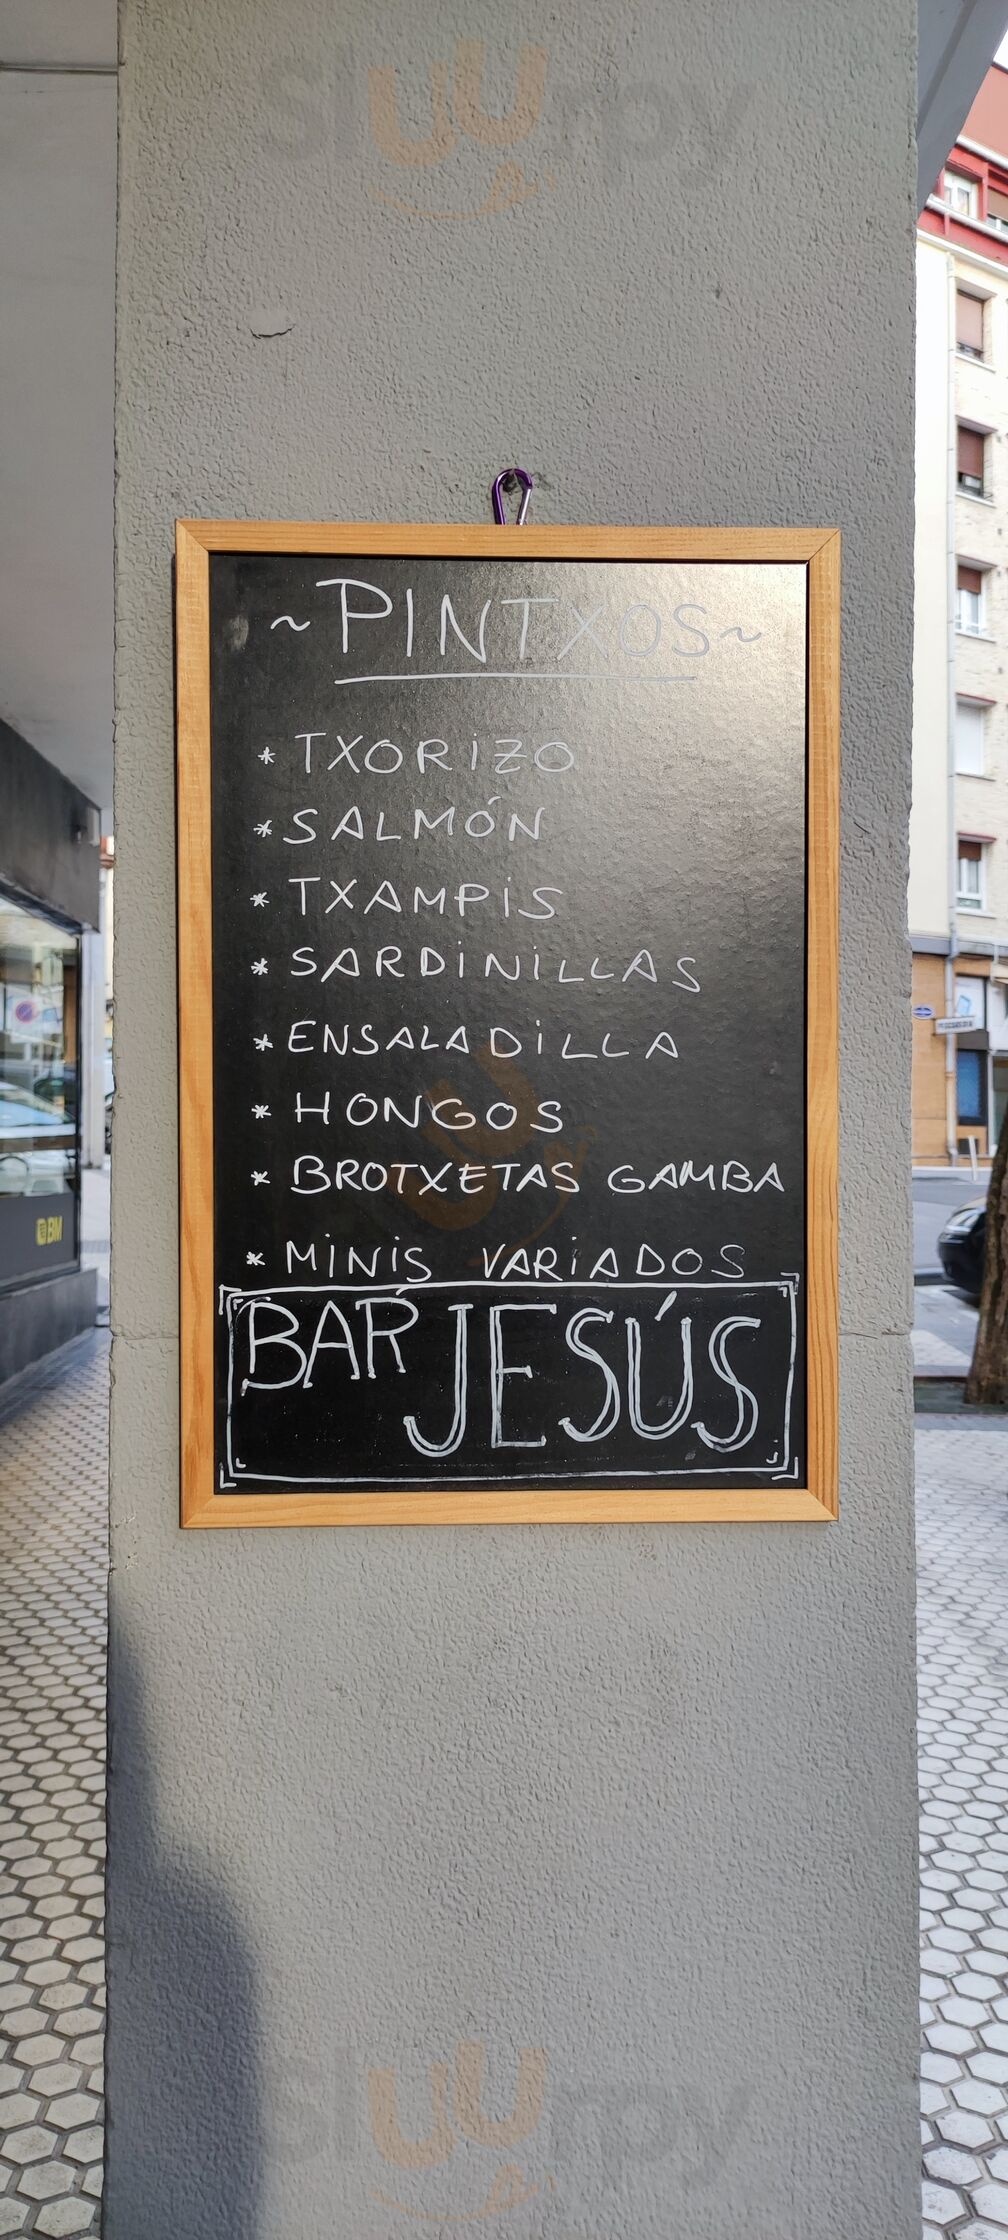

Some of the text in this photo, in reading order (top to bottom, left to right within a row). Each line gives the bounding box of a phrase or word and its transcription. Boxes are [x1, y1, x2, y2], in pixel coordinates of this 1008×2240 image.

[315, 579, 710, 662] PINTXOS
[295, 732, 575, 774] TXORIZO
[283, 796, 545, 845] SALMÓN
[288, 876, 563, 919] TXAMPIS
[290, 941, 700, 993] SARDINILLAS
[287, 1020, 679, 1060] ENSALADILLA
[295, 1092, 564, 1133] HONGOS
[291, 1155, 785, 1195] BROTXETAS GAMBA
[286, 1233, 746, 1282] MINIS VARIADOS
[238, 1291, 762, 1458] BAR JESÚS
